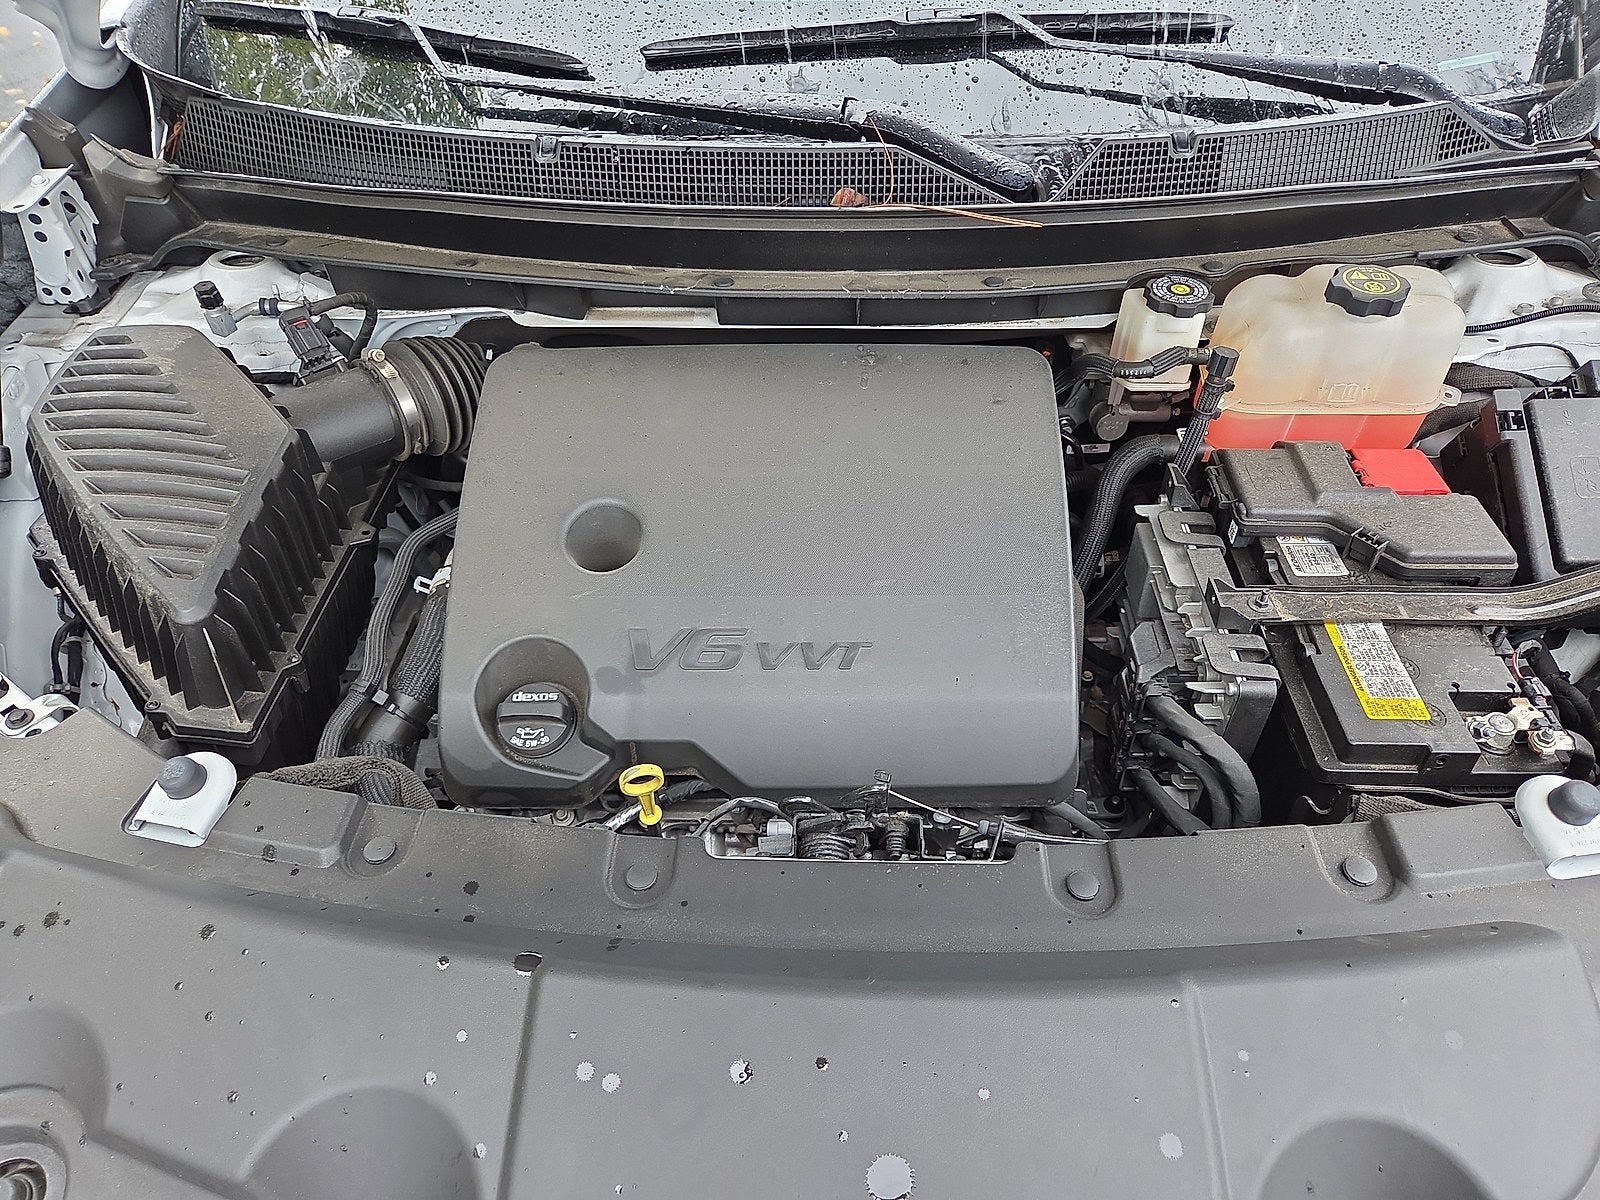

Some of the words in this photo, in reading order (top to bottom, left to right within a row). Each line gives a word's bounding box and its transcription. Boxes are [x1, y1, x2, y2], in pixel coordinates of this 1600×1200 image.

[627, 628, 749, 671] V6
[756, 641, 873, 671] VVT
[1337, 645, 1351, 664] POISON
[1346, 664, 1361, 686] DANGER
[512, 691, 560, 702] dexos
[510, 736, 525, 747] SAE
[525, 736, 551, 748] 5W-30
